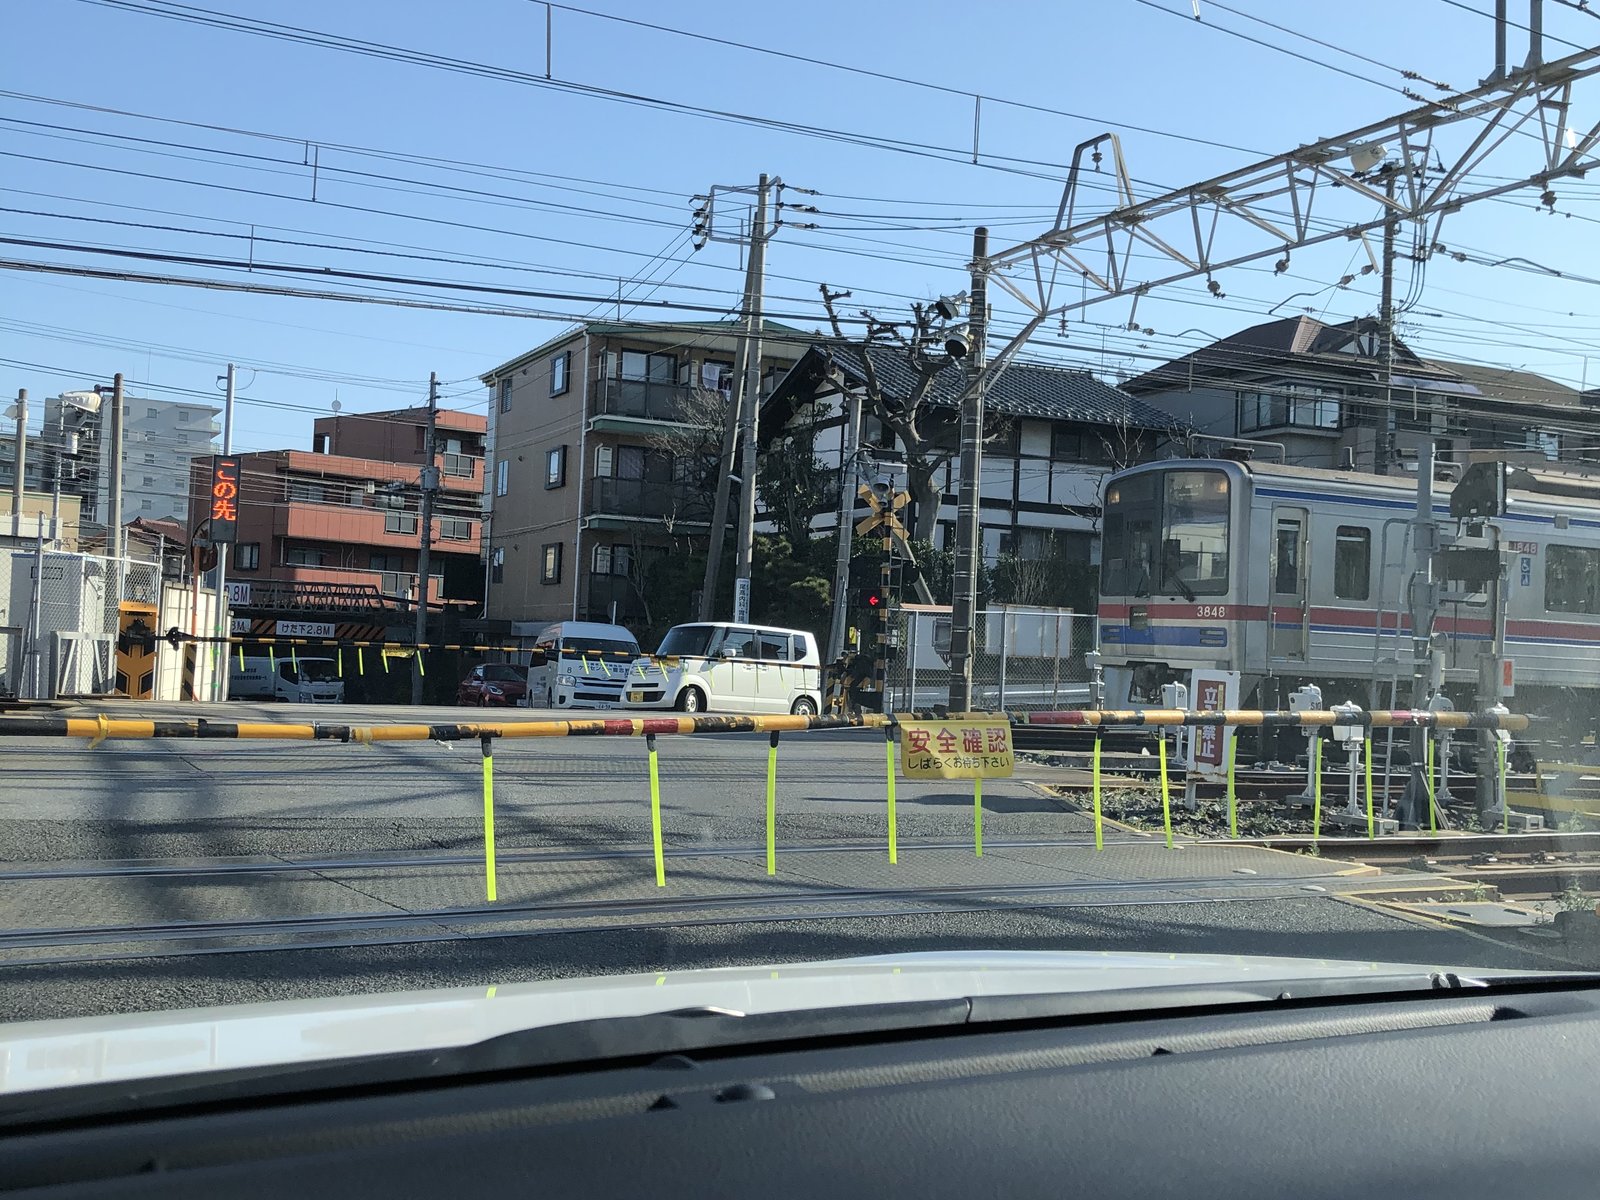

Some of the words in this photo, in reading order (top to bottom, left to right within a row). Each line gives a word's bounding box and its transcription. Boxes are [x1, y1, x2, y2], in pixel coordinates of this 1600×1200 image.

[213, 462, 236, 520] この先
[1196, 606, 1225, 617] 3848
[908, 728, 1008, 754] 安全確認
[908, 757, 1010, 770] しばらくお待ち下さい
